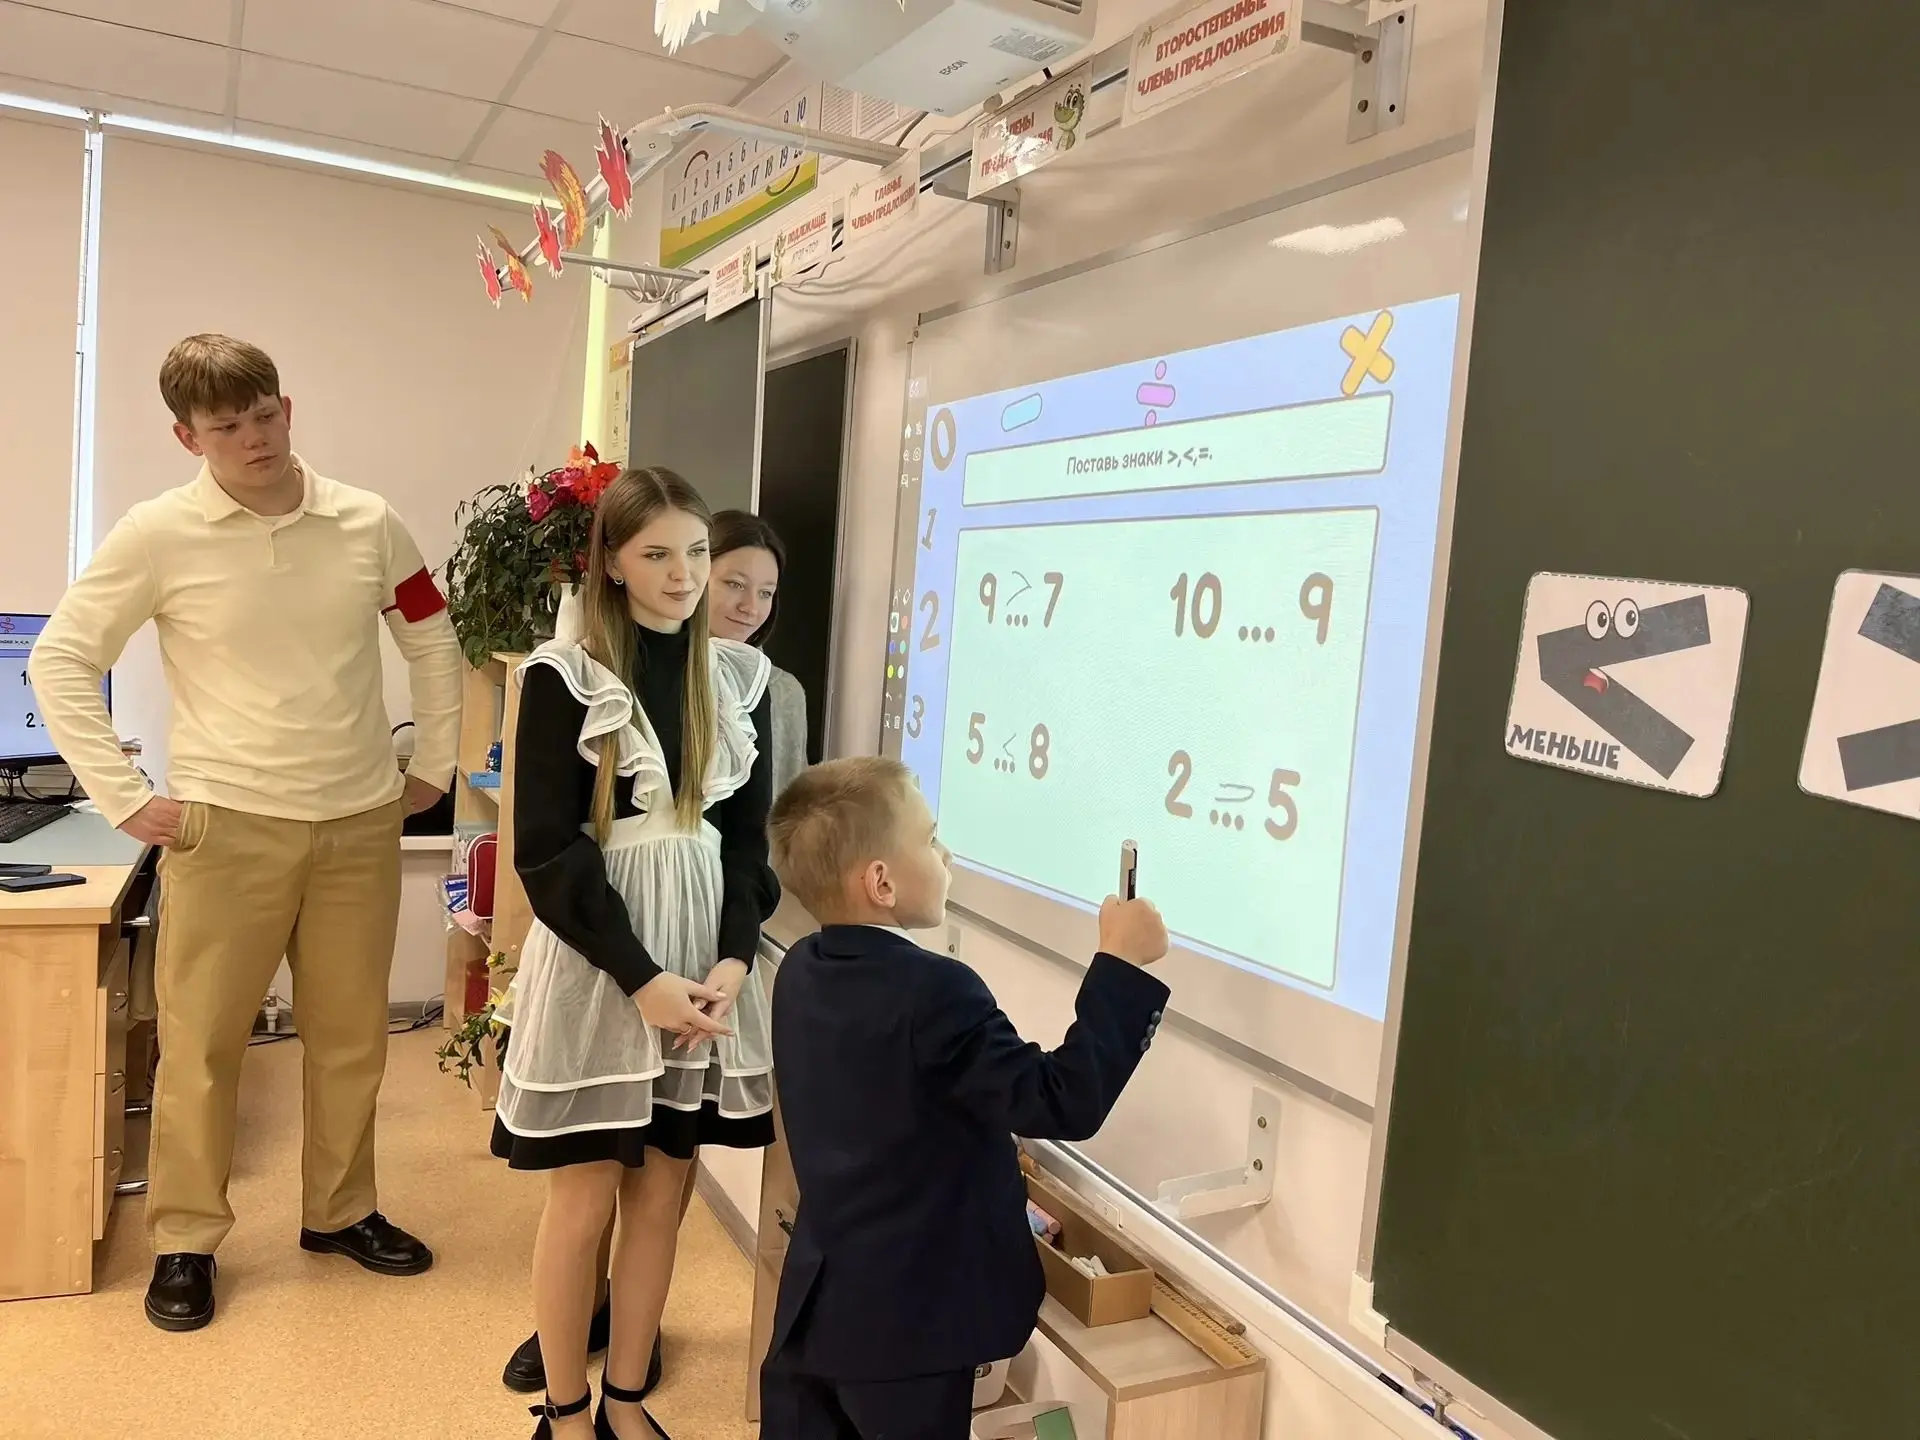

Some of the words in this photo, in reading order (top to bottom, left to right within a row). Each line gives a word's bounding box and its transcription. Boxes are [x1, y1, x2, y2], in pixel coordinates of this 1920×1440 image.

[1138, 63, 1178, 96] ЧЛЕНЫ
[1180, 12, 1286, 78] ПРЕДЛОЖЕНИЯ
[1156, 0, 1267, 62] ВТОРОСТЕПЕННЫЕ
[939, 59, 968, 76] EPSON
[671, 193, 677, 211] 0
[693, 178, 698, 196] 2
[704, 169, 709, 188] 3
[728, 152, 733, 172] 5
[740, 142, 746, 162] 6
[797, 97, 807, 123] 10
[690, 208, 697, 228] 12
[702, 200, 709, 220] 13
[725, 184, 733, 205] 15
[737, 174, 746, 197] 16
[750, 165, 760, 188] 17
[765, 155, 774, 179] 18
[779, 146, 789, 169] 19
[852, 210, 876, 230] ЧЛЕНЫ
[1066, 456, 1119, 475] Поставь
[1122, 450, 1163, 469] знаки
[921, 507, 937, 551] 1
[919, 590, 940, 652] 2
[979, 572, 997, 625] 9
[1043, 572, 1064, 628] 7
[1169, 572, 1223, 638] 10
[1298, 572, 1335, 646] 9
[906, 694, 925, 739] 3
[966, 711, 987, 765] 5
[1028, 723, 1051, 780] 8
[1507, 724, 1621, 770] МЕНЬШЕ
[1164, 749, 1194, 819] 2
[1264, 768, 1302, 841] 5
